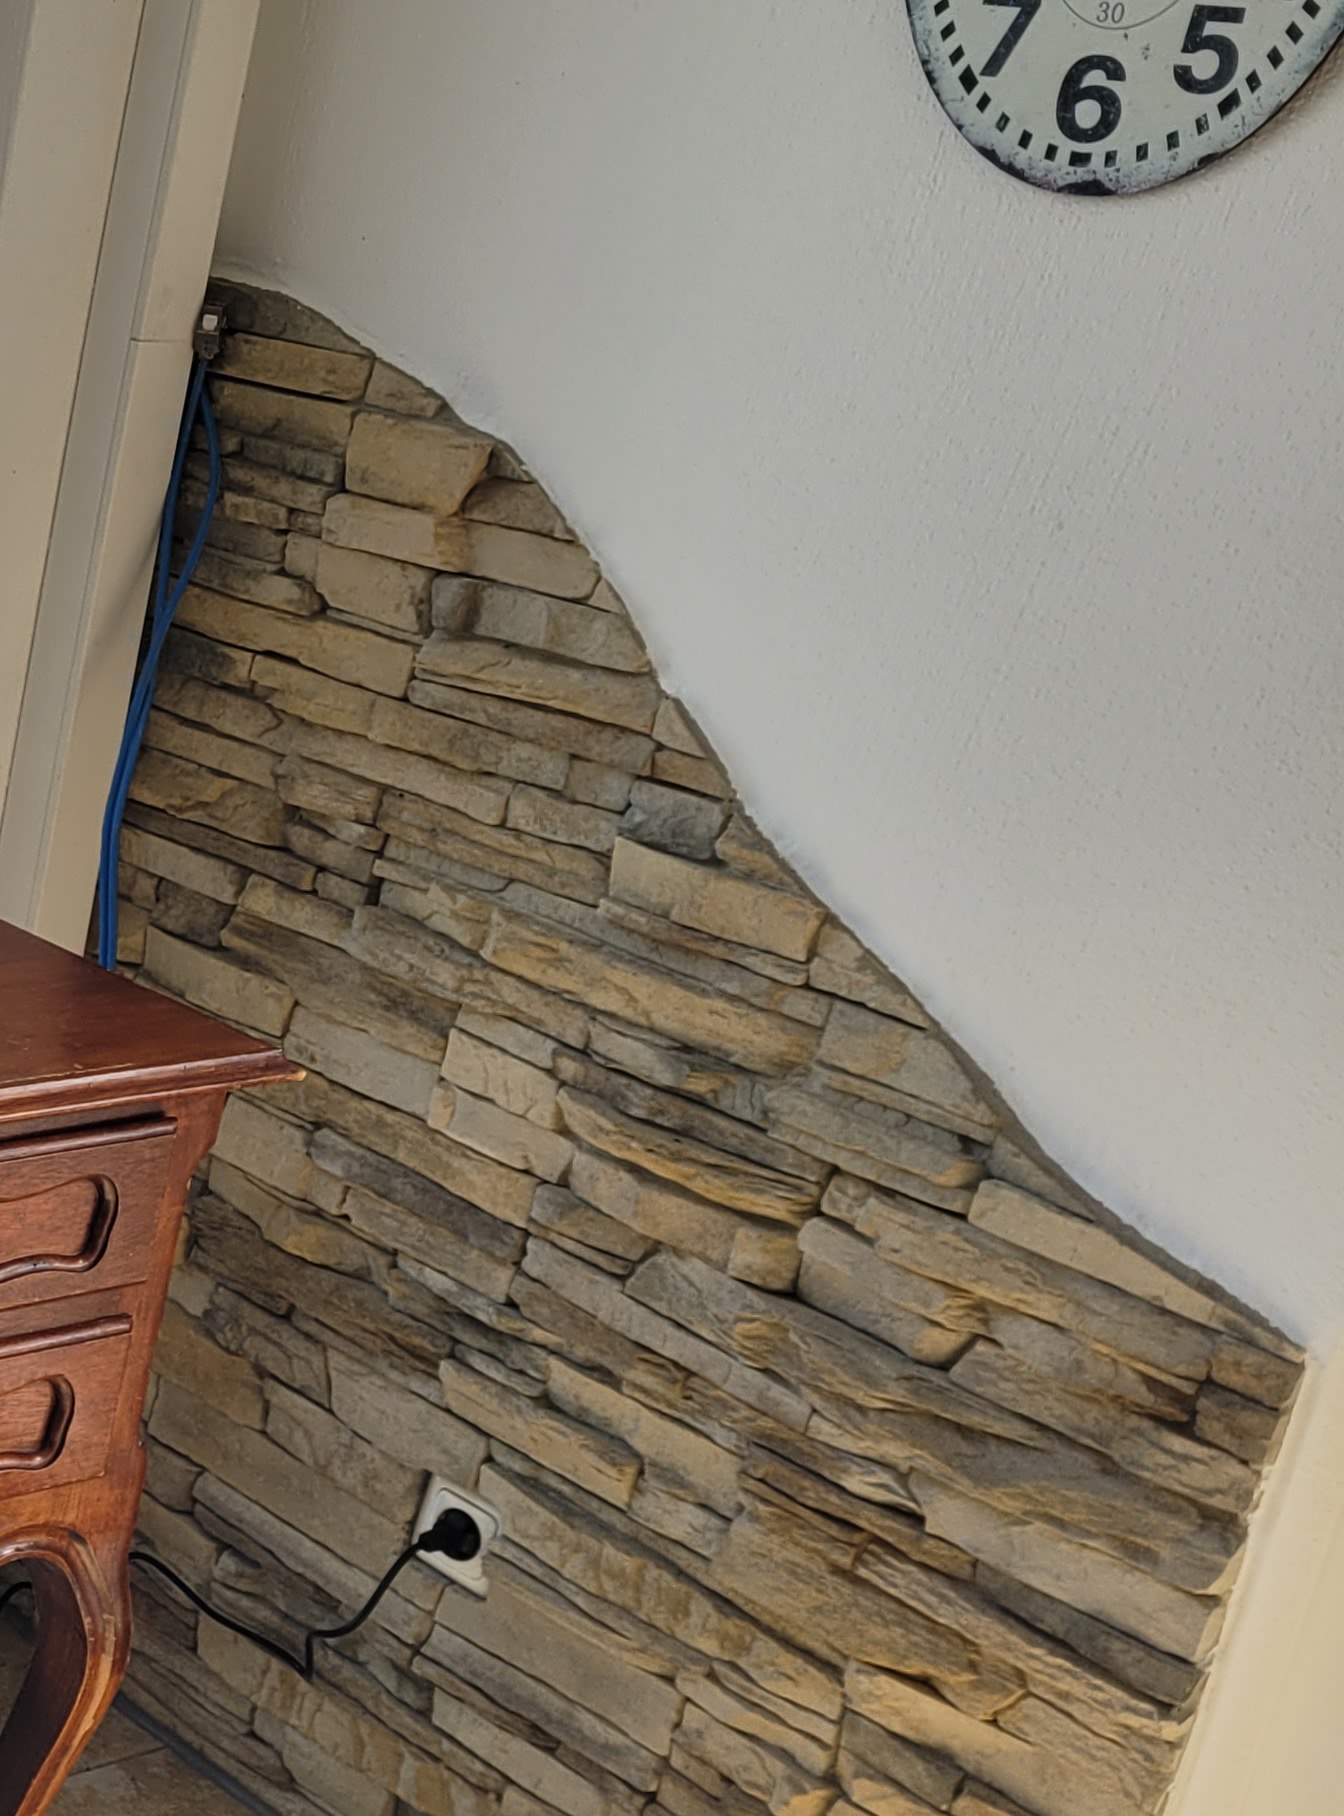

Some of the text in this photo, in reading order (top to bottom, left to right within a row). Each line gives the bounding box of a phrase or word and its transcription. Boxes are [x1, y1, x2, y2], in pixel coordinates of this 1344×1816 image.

[979, 0, 1042, 77] 7
[1096, 1, 1125, 24] 30
[1173, 4, 1247, 94] 5
[1056, 54, 1127, 143] 6
